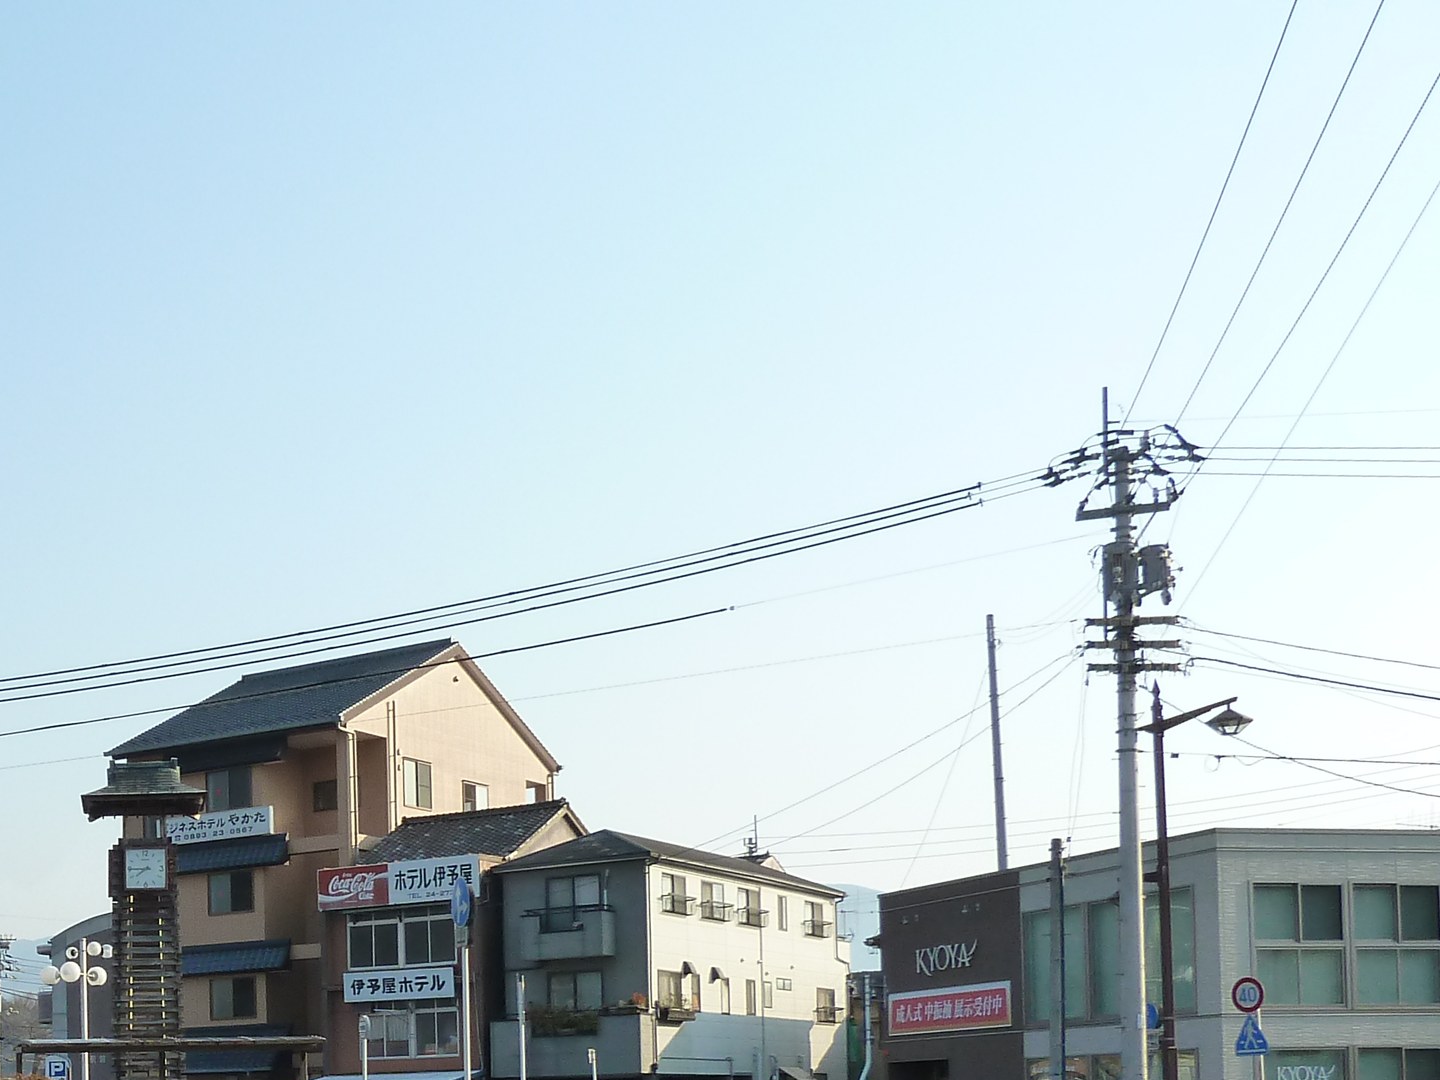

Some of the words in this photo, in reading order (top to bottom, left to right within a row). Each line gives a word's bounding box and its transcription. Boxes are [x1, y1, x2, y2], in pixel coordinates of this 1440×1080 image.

[167, 812, 266, 834] ジネスホテルやかた
[394, 863, 472, 891] ホテル伊予屋
[915, 939, 977, 976] KYOYA
[350, 974, 446, 996] 伊予屋ホテル
[1239, 986, 1258, 1003] 40
[50, 1062, 64, 1077] P
